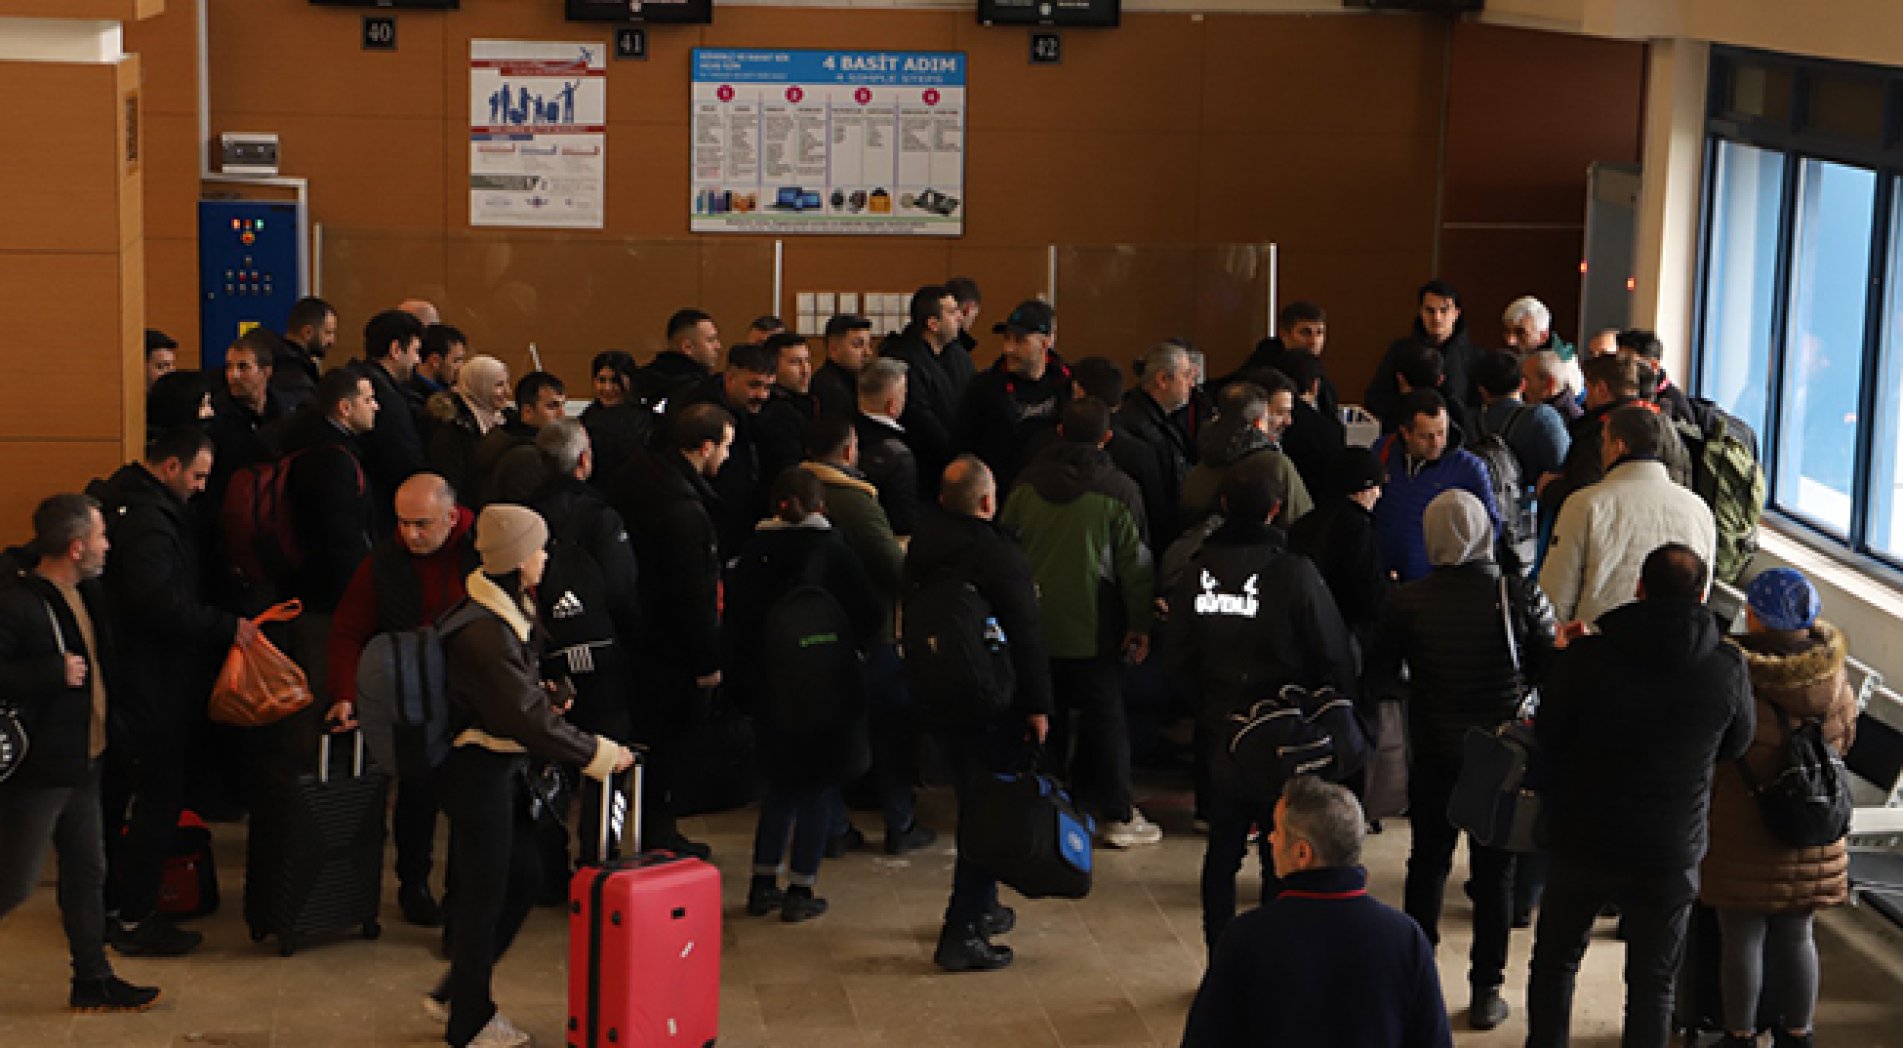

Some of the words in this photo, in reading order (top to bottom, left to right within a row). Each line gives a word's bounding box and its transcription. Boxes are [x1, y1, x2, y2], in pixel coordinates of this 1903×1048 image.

[368, 22, 391, 42] 40
[619, 32, 642, 53] 41
[1035, 37, 1058, 57] 42
[822, 55, 836, 70] 4
[840, 53, 899, 71] BASİT
[903, 57, 957, 73] ADIM
